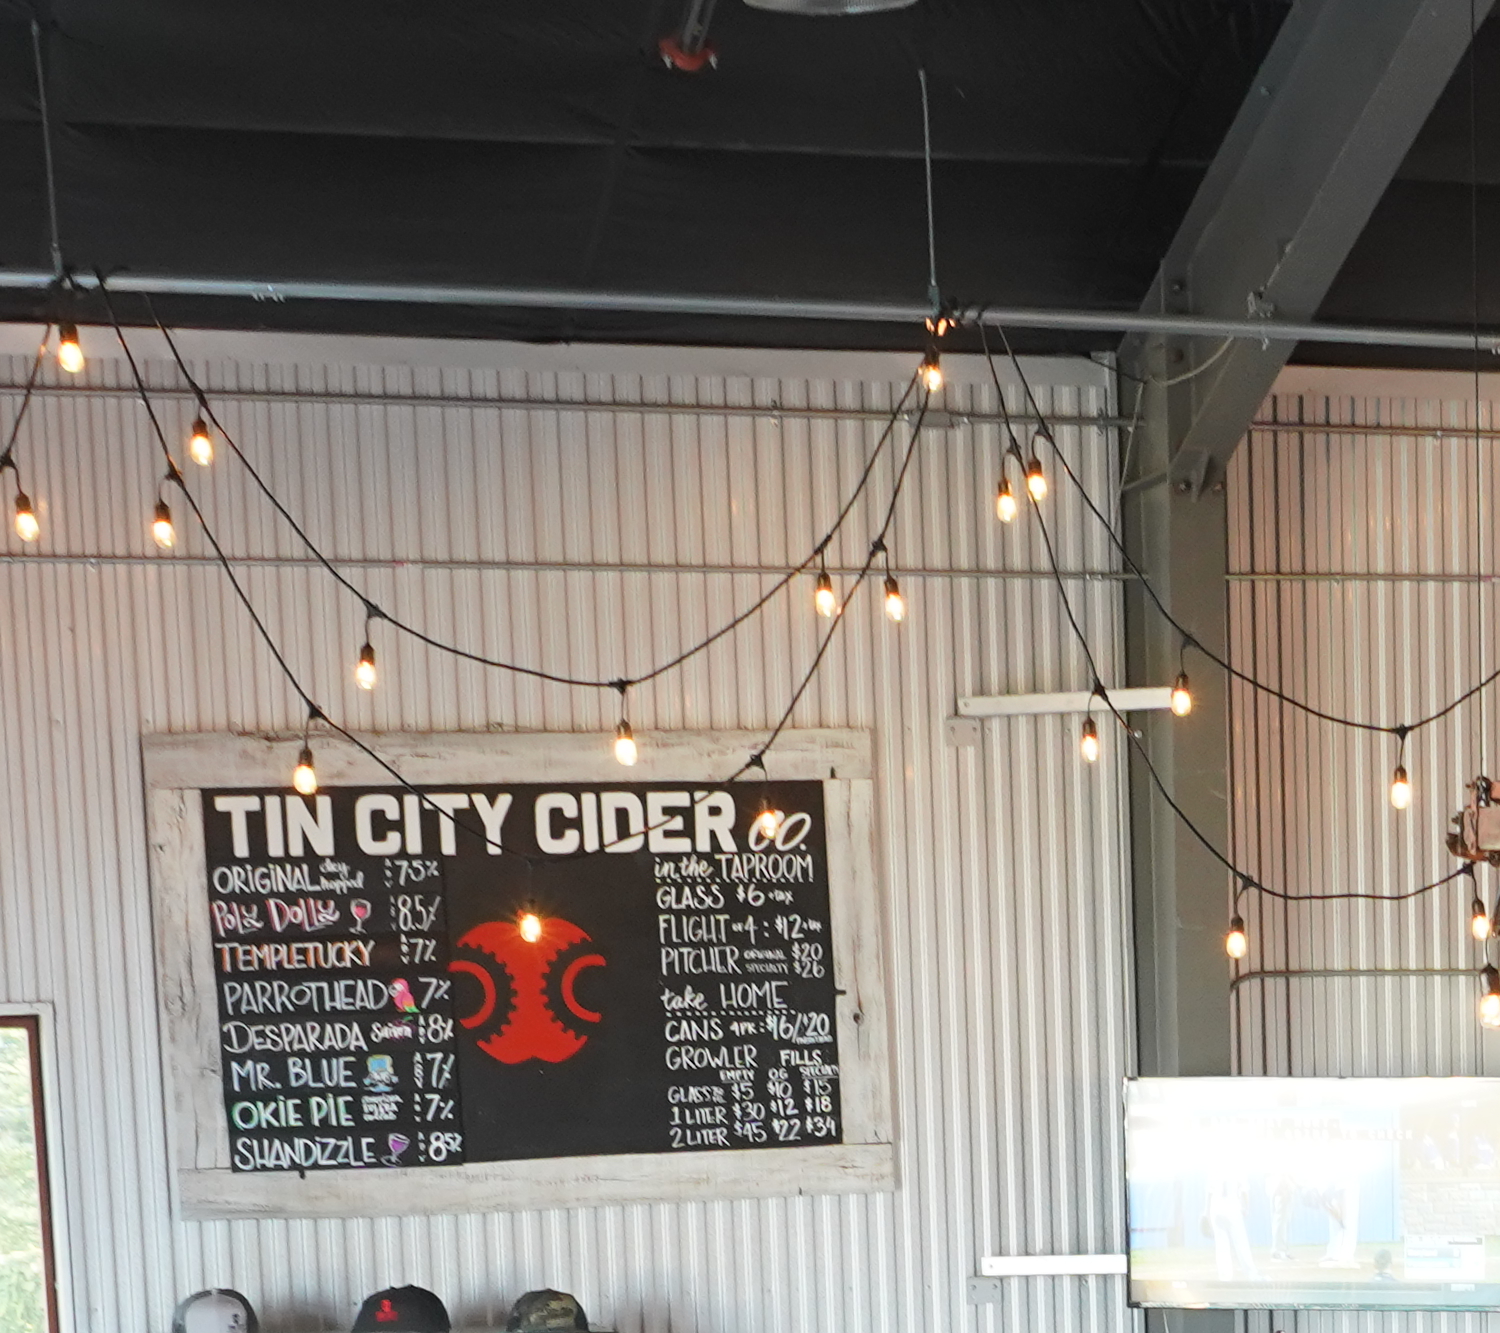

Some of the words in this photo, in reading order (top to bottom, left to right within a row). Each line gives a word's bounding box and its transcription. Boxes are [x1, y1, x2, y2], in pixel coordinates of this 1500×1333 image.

[213, 795, 335, 858] TIN
[354, 793, 512, 857] CITY
[535, 791, 737, 855] CIDER
[680, 854, 714, 877] the
[714, 853, 814, 881] TAPROOM
[656, 884, 725, 910] GLASS
[736, 884, 765, 907] $6
[658, 913, 730, 944] FLIGHT
[774, 913, 804, 941] $12
[214, 940, 376, 973] TEMPLETUCKY
[660, 945, 742, 976] PITCHER
[791, 942, 824, 961] $20
[794, 960, 825, 979] $26
[223, 977, 389, 1016] PARROTHEAD
[660, 985, 708, 1010] take
[719, 981, 789, 1010] HOME
[222, 1020, 369, 1054] DESPARADA
[665, 1018, 725, 1043] CANS
[665, 1044, 759, 1070] GROWLER
[780, 1049, 823, 1067] FILLS
[230, 1058, 283, 1092] MR.
[287, 1056, 358, 1088] BLUE
[731, 1082, 754, 1101] $5
[766, 1081, 792, 1099] $10
[803, 1079, 831, 1096] $15
[232, 1094, 304, 1131] OKIE
[309, 1092, 356, 1127] PIE
[669, 1106, 680, 1126] 1
[683, 1106, 729, 1126] LITER
[769, 1098, 799, 1117] $12
[669, 1127, 685, 1148] 2
[686, 1127, 731, 1147] LITER
[733, 1120, 767, 1143] $45
[771, 1118, 801, 1141] $22
[805, 1115, 837, 1137] $34
[233, 1136, 377, 1170] SHANDIZZLE
